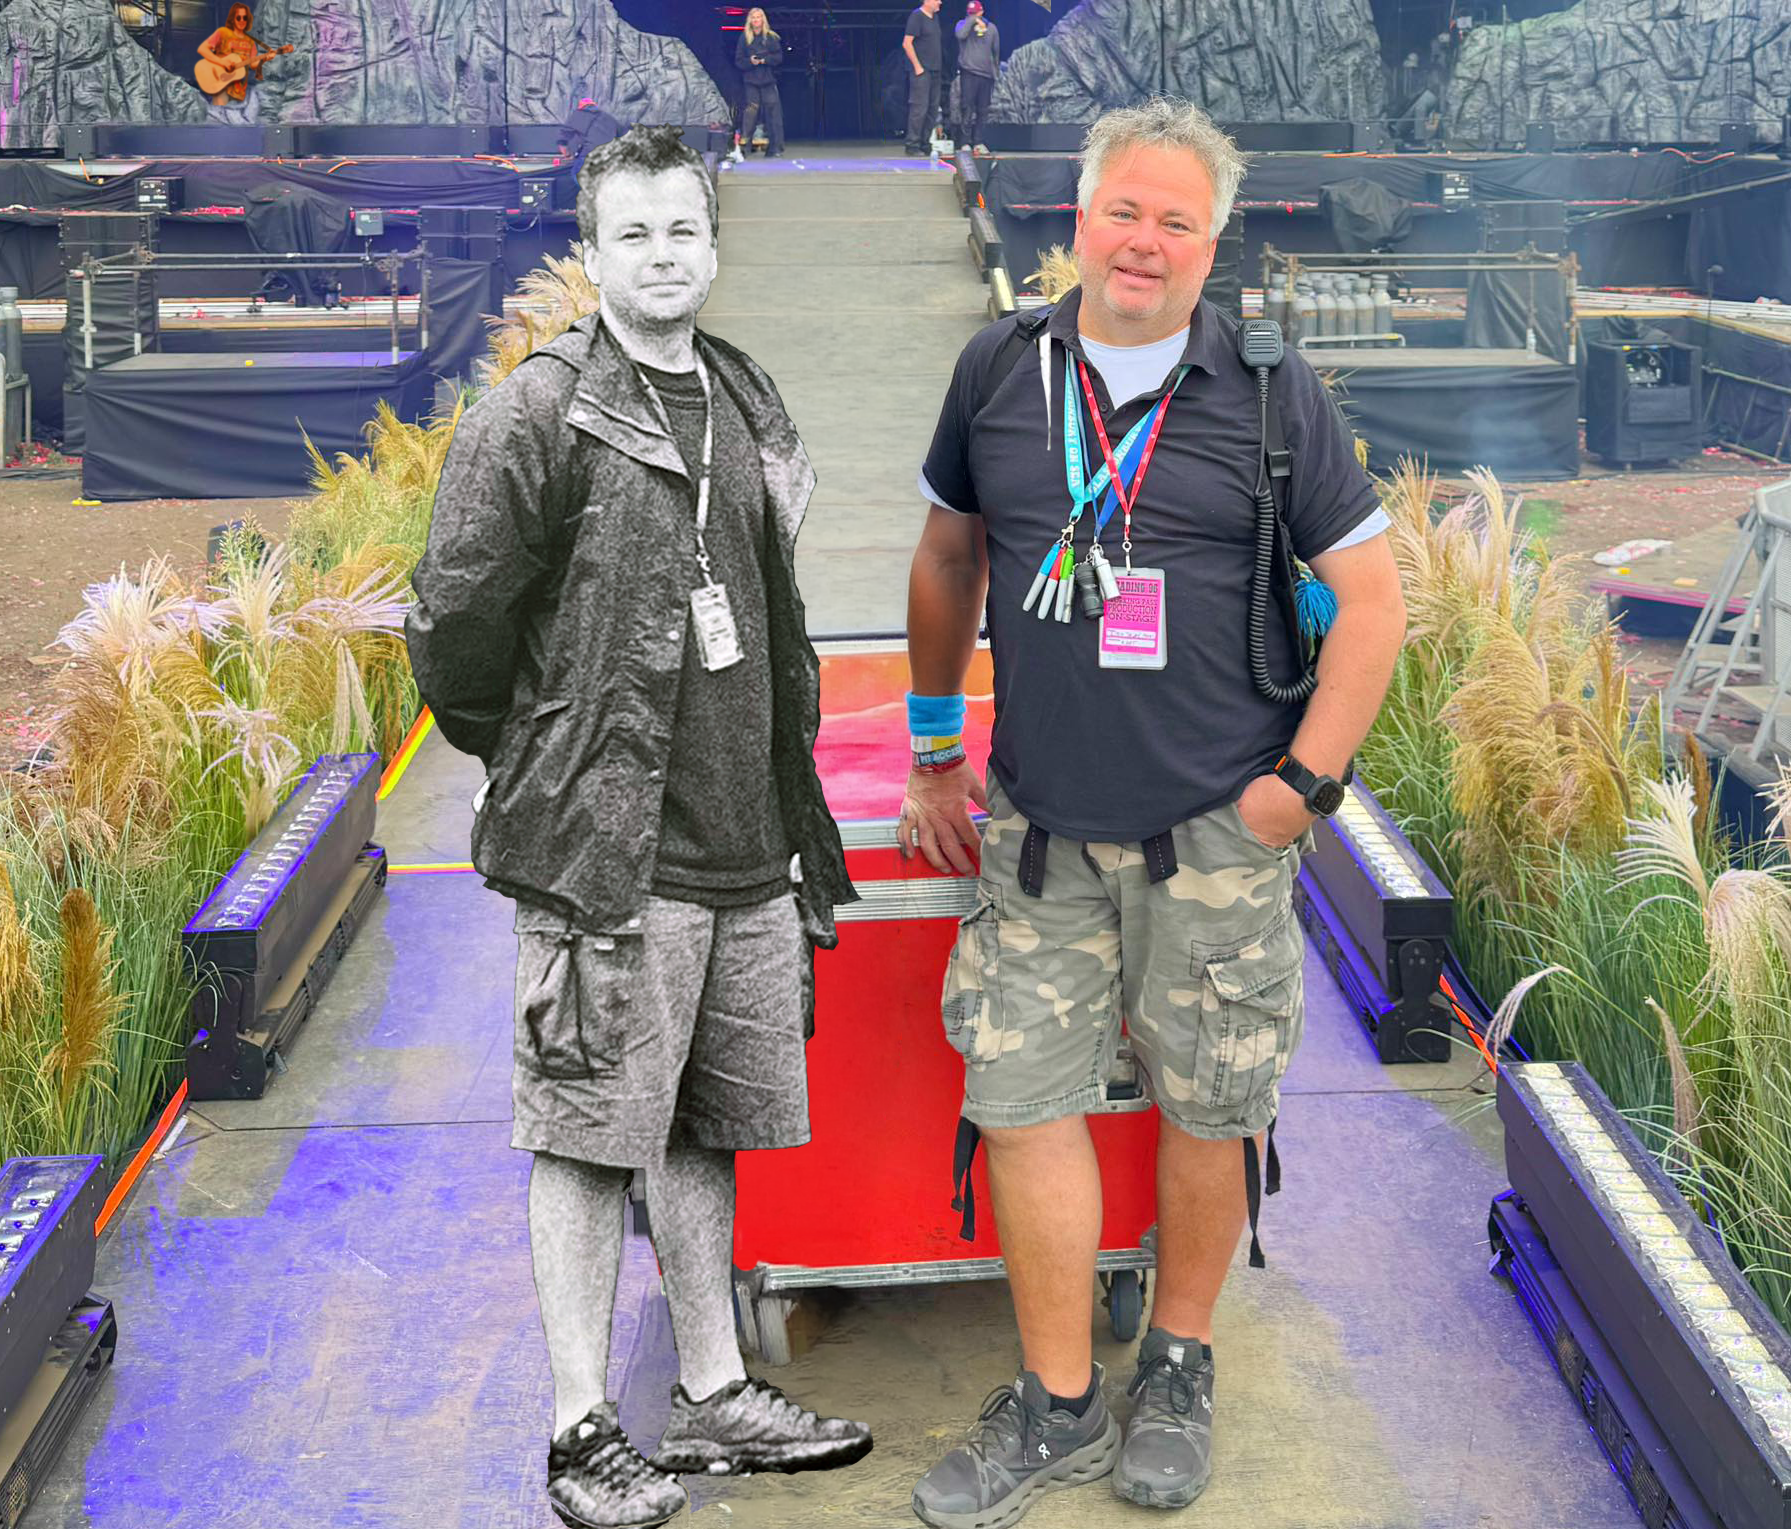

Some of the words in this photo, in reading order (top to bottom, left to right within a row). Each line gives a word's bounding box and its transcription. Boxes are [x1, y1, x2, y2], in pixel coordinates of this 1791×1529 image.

[1069, 447, 1079, 462] ON
[1070, 465, 1081, 488] SEA
[1108, 602, 1157, 615] PRODUCTION
